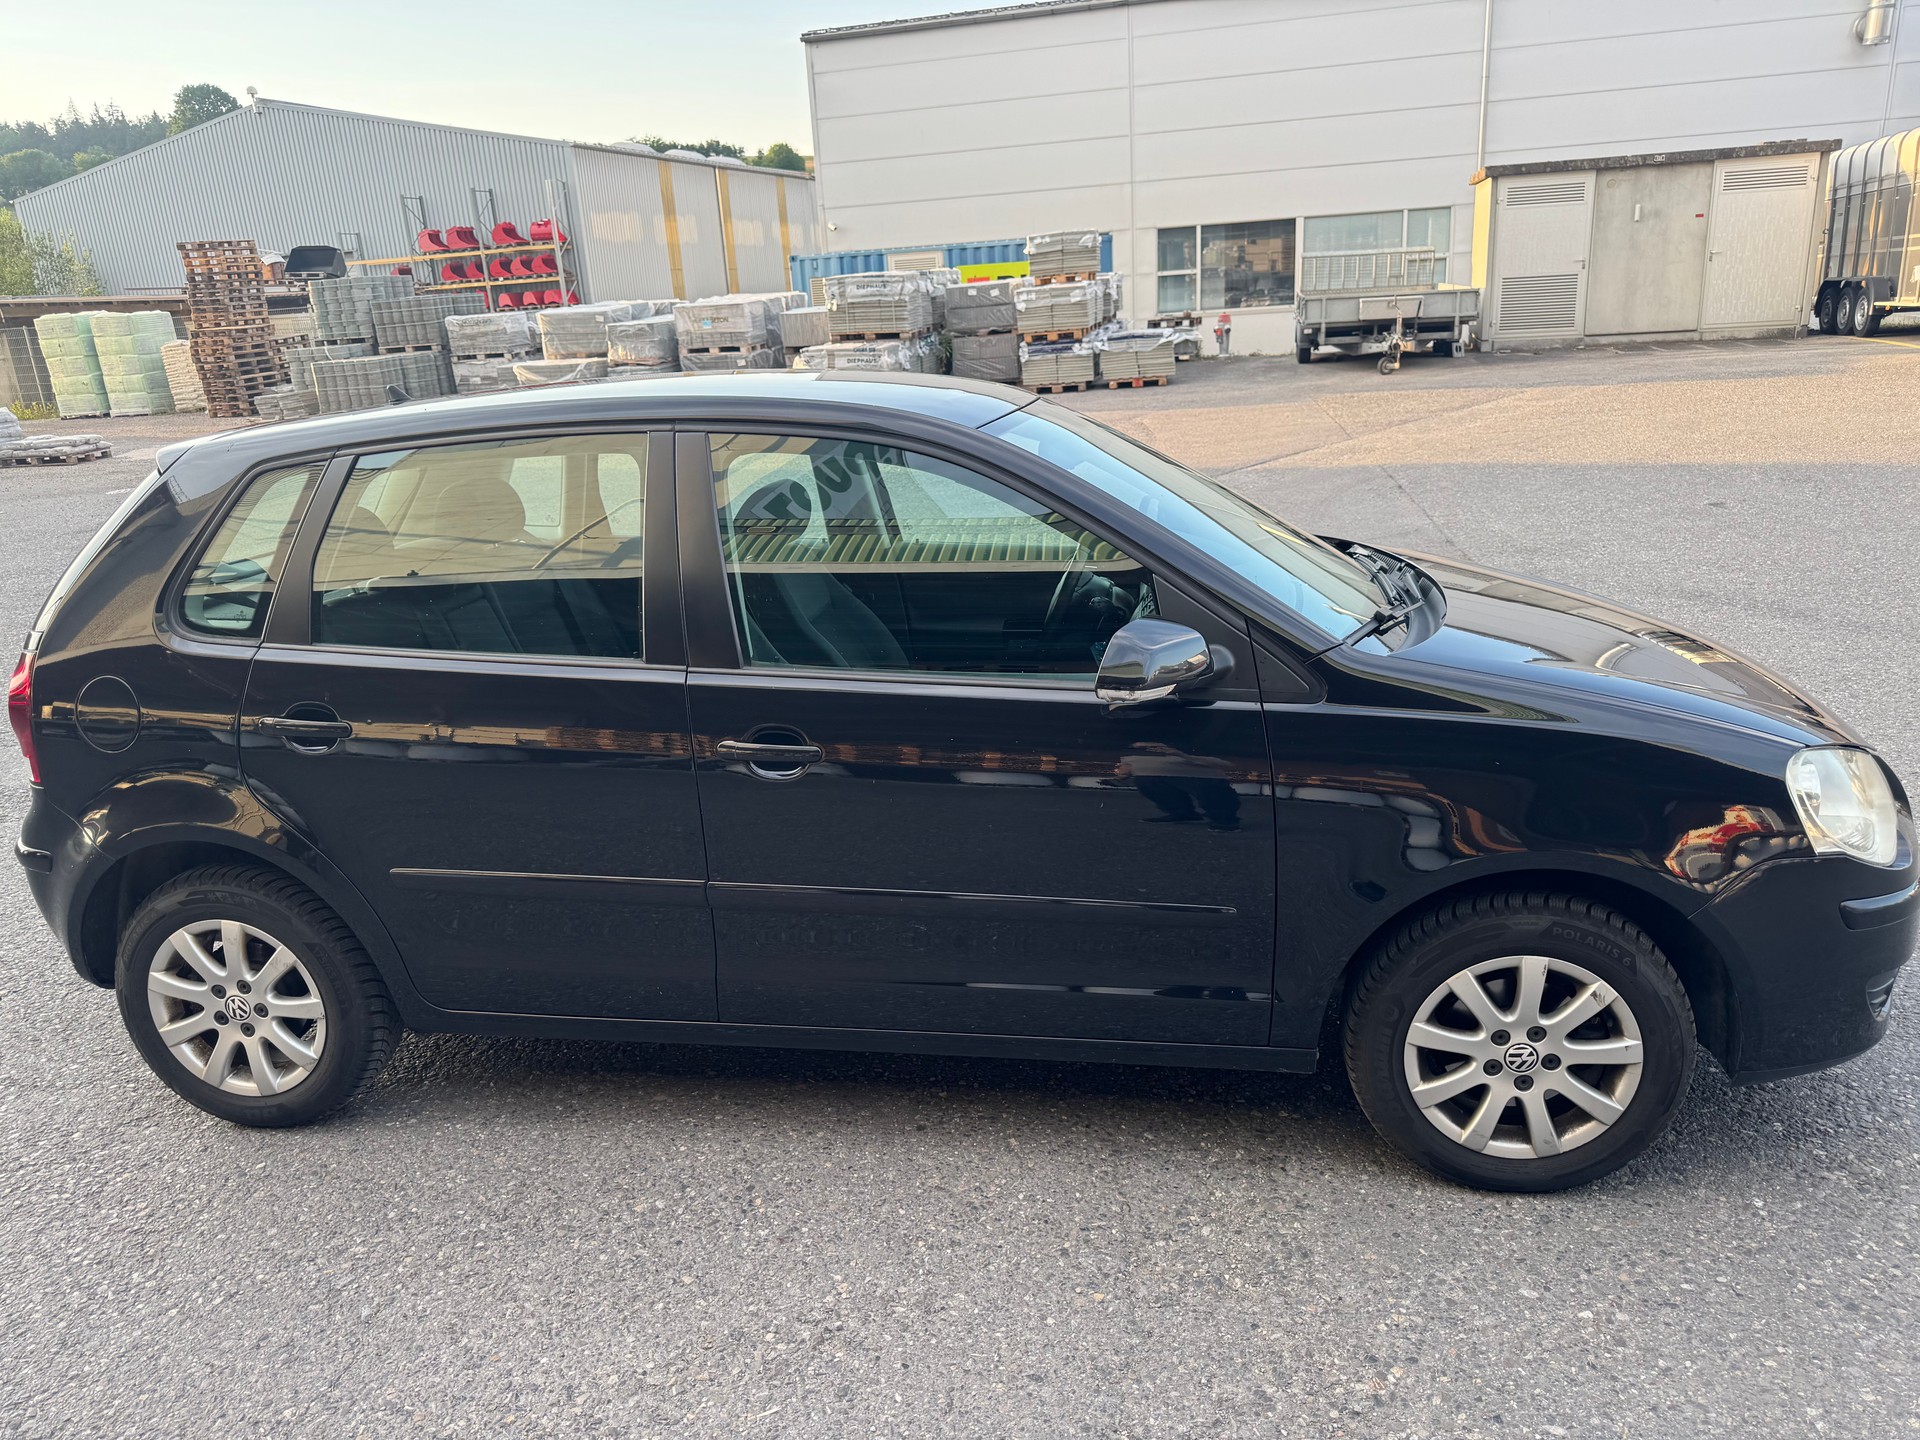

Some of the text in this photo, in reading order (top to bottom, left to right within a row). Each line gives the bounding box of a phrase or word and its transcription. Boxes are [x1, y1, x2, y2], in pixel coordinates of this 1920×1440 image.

[856, 282, 887, 291] DIEPHAUS
[846, 357, 877, 365] DIEPHAUS
[1552, 927, 1632, 967] POLARIS 6
[225, 995, 251, 1021] VW
[1504, 1043, 1540, 1073] VW
